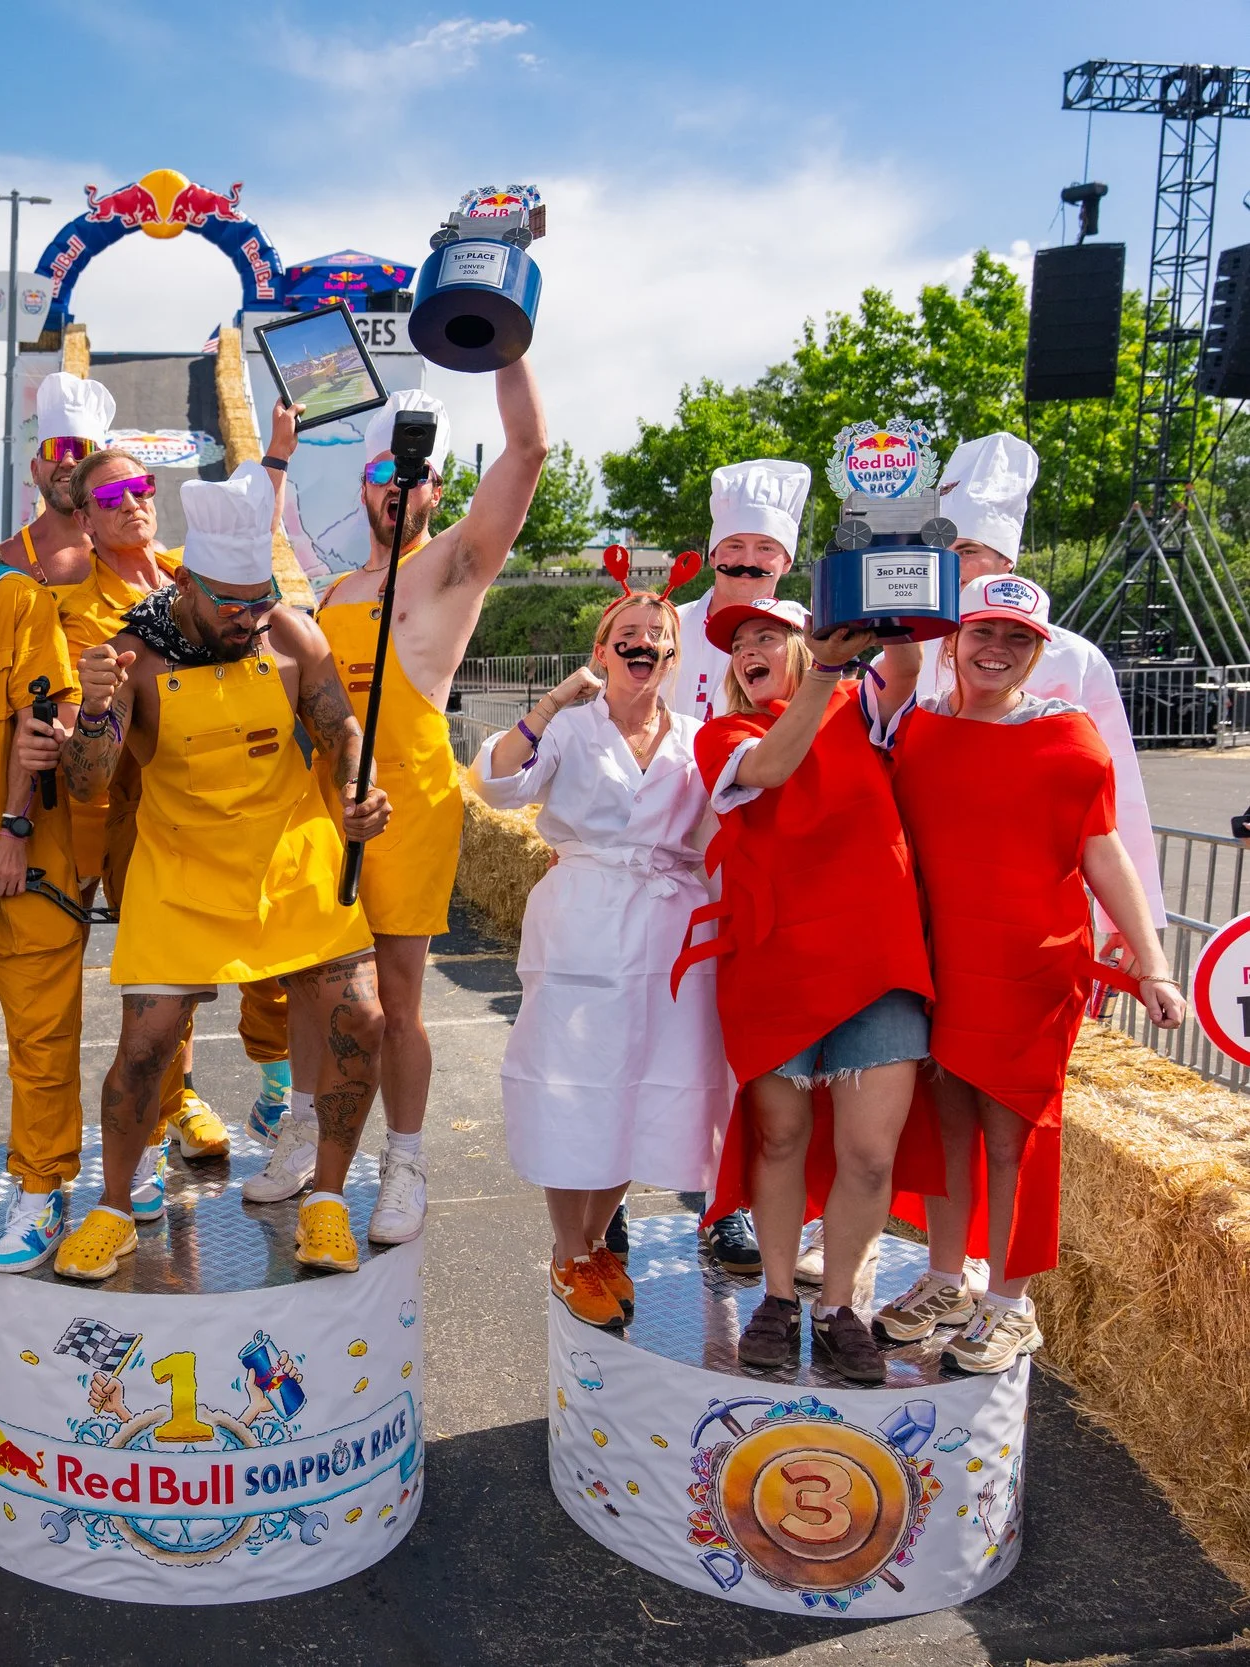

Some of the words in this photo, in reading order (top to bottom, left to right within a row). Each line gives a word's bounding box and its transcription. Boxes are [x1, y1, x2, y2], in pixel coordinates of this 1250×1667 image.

[59, 235, 86, 267] Bull
[466, 253, 496, 261] PLACE
[242, 237, 270, 272] Red
[256, 269, 276, 300] Bull
[848, 454, 881, 470] Red
[883, 452, 916, 468] Bull
[857, 467, 908, 481] SOAPBOX
[869, 482, 898, 494] RACE
[876, 567, 894, 577] 3RD
[896, 566, 929, 576] PLACE
[151, 1351, 214, 1442] 1
[57, 1454, 141, 1504] Red
[150, 1464, 234, 1505] Bull
[245, 1438, 368, 1496] SOAPBOX
[370, 1409, 406, 1460] RACE
[778, 1458, 854, 1545] 3
